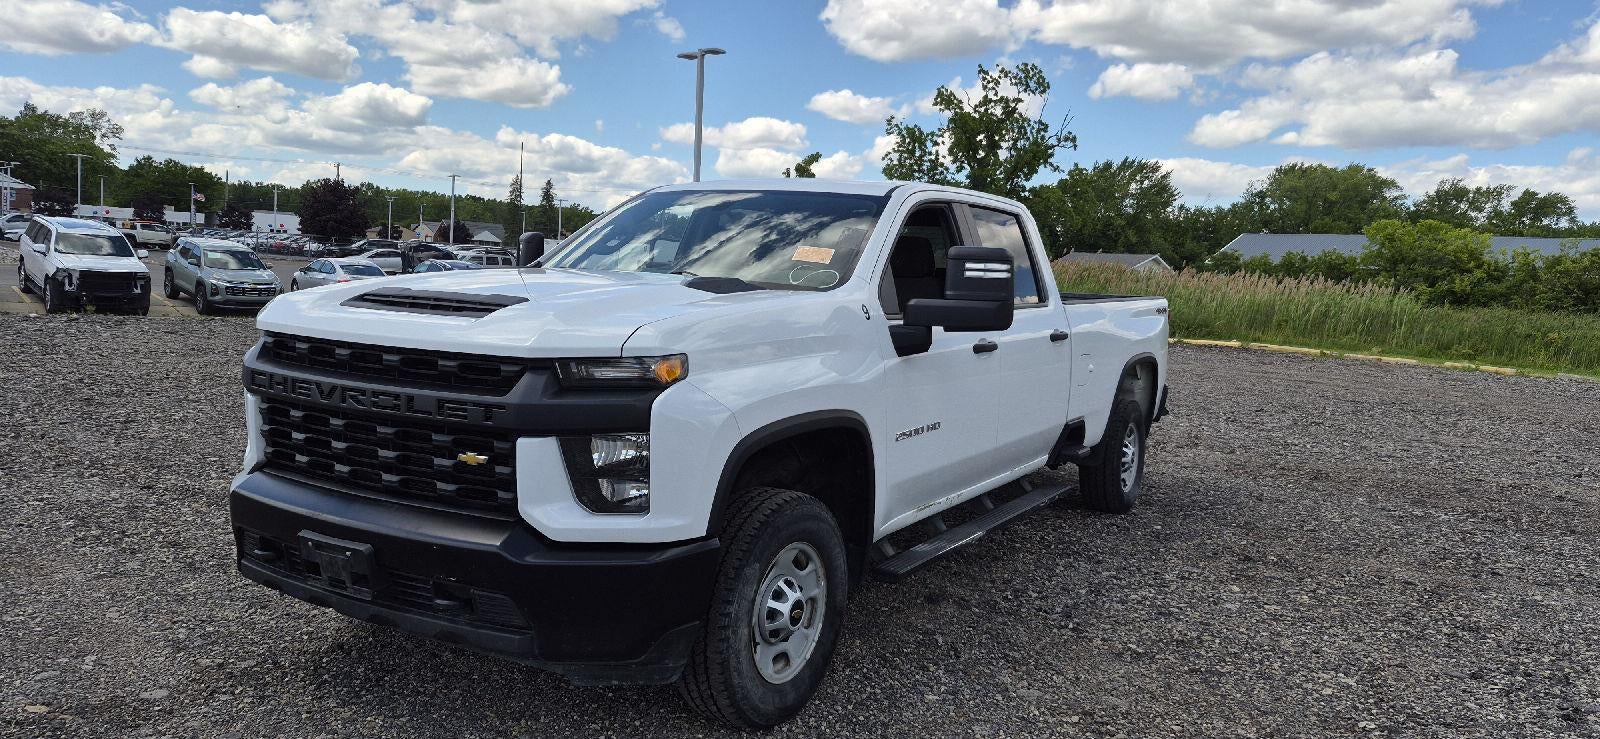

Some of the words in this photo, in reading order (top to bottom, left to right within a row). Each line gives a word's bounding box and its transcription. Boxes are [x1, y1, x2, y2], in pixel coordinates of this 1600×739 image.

[861, 303, 871, 320] 9
[250, 369, 507, 424] CHEVROLET
[895, 426, 925, 441] 2500
[926, 421, 941, 432] HD
